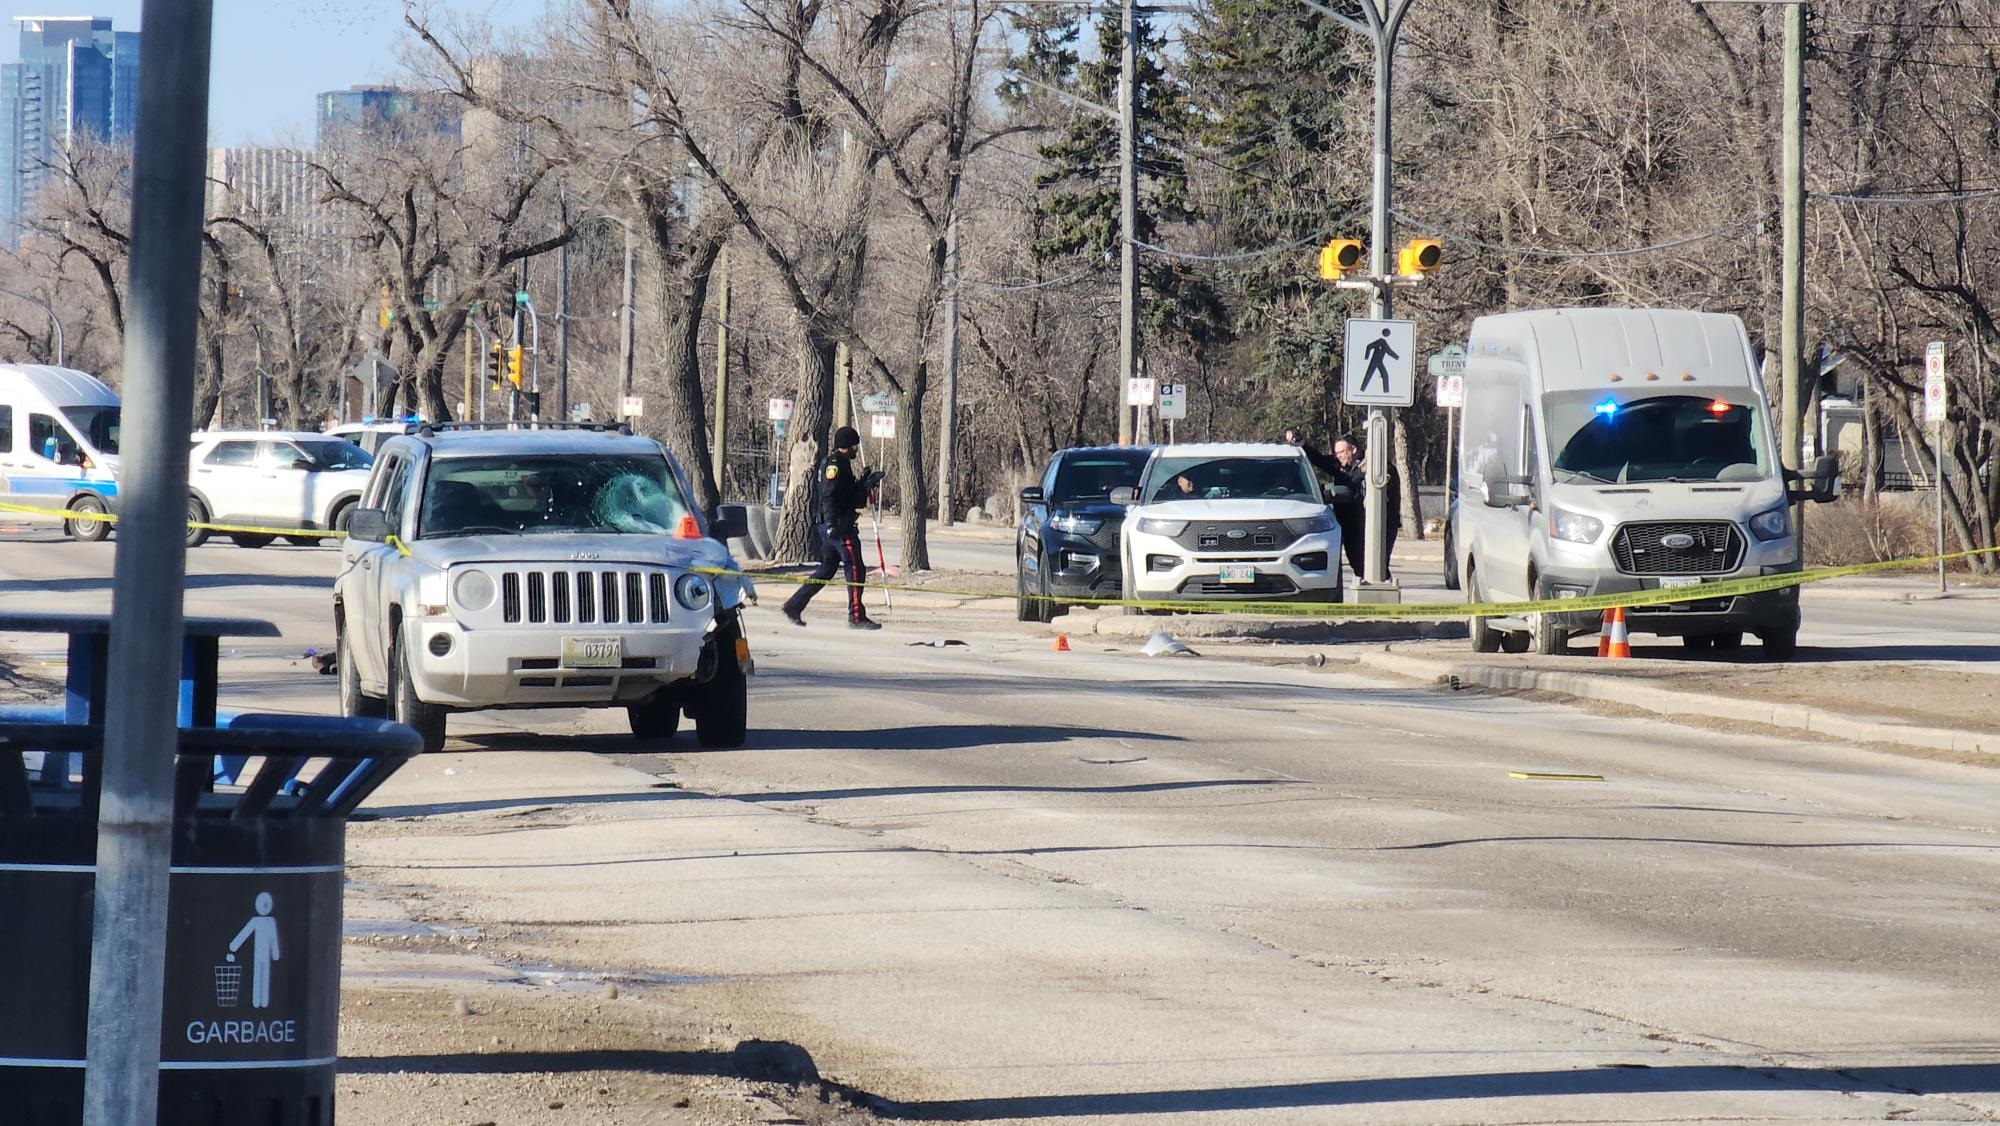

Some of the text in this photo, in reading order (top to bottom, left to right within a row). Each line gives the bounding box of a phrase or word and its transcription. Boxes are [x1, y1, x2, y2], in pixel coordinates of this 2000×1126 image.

[686, 521, 693, 532] 7
[1060, 638, 1066, 647] 2
[186, 1020, 296, 1044] GARBAGE
